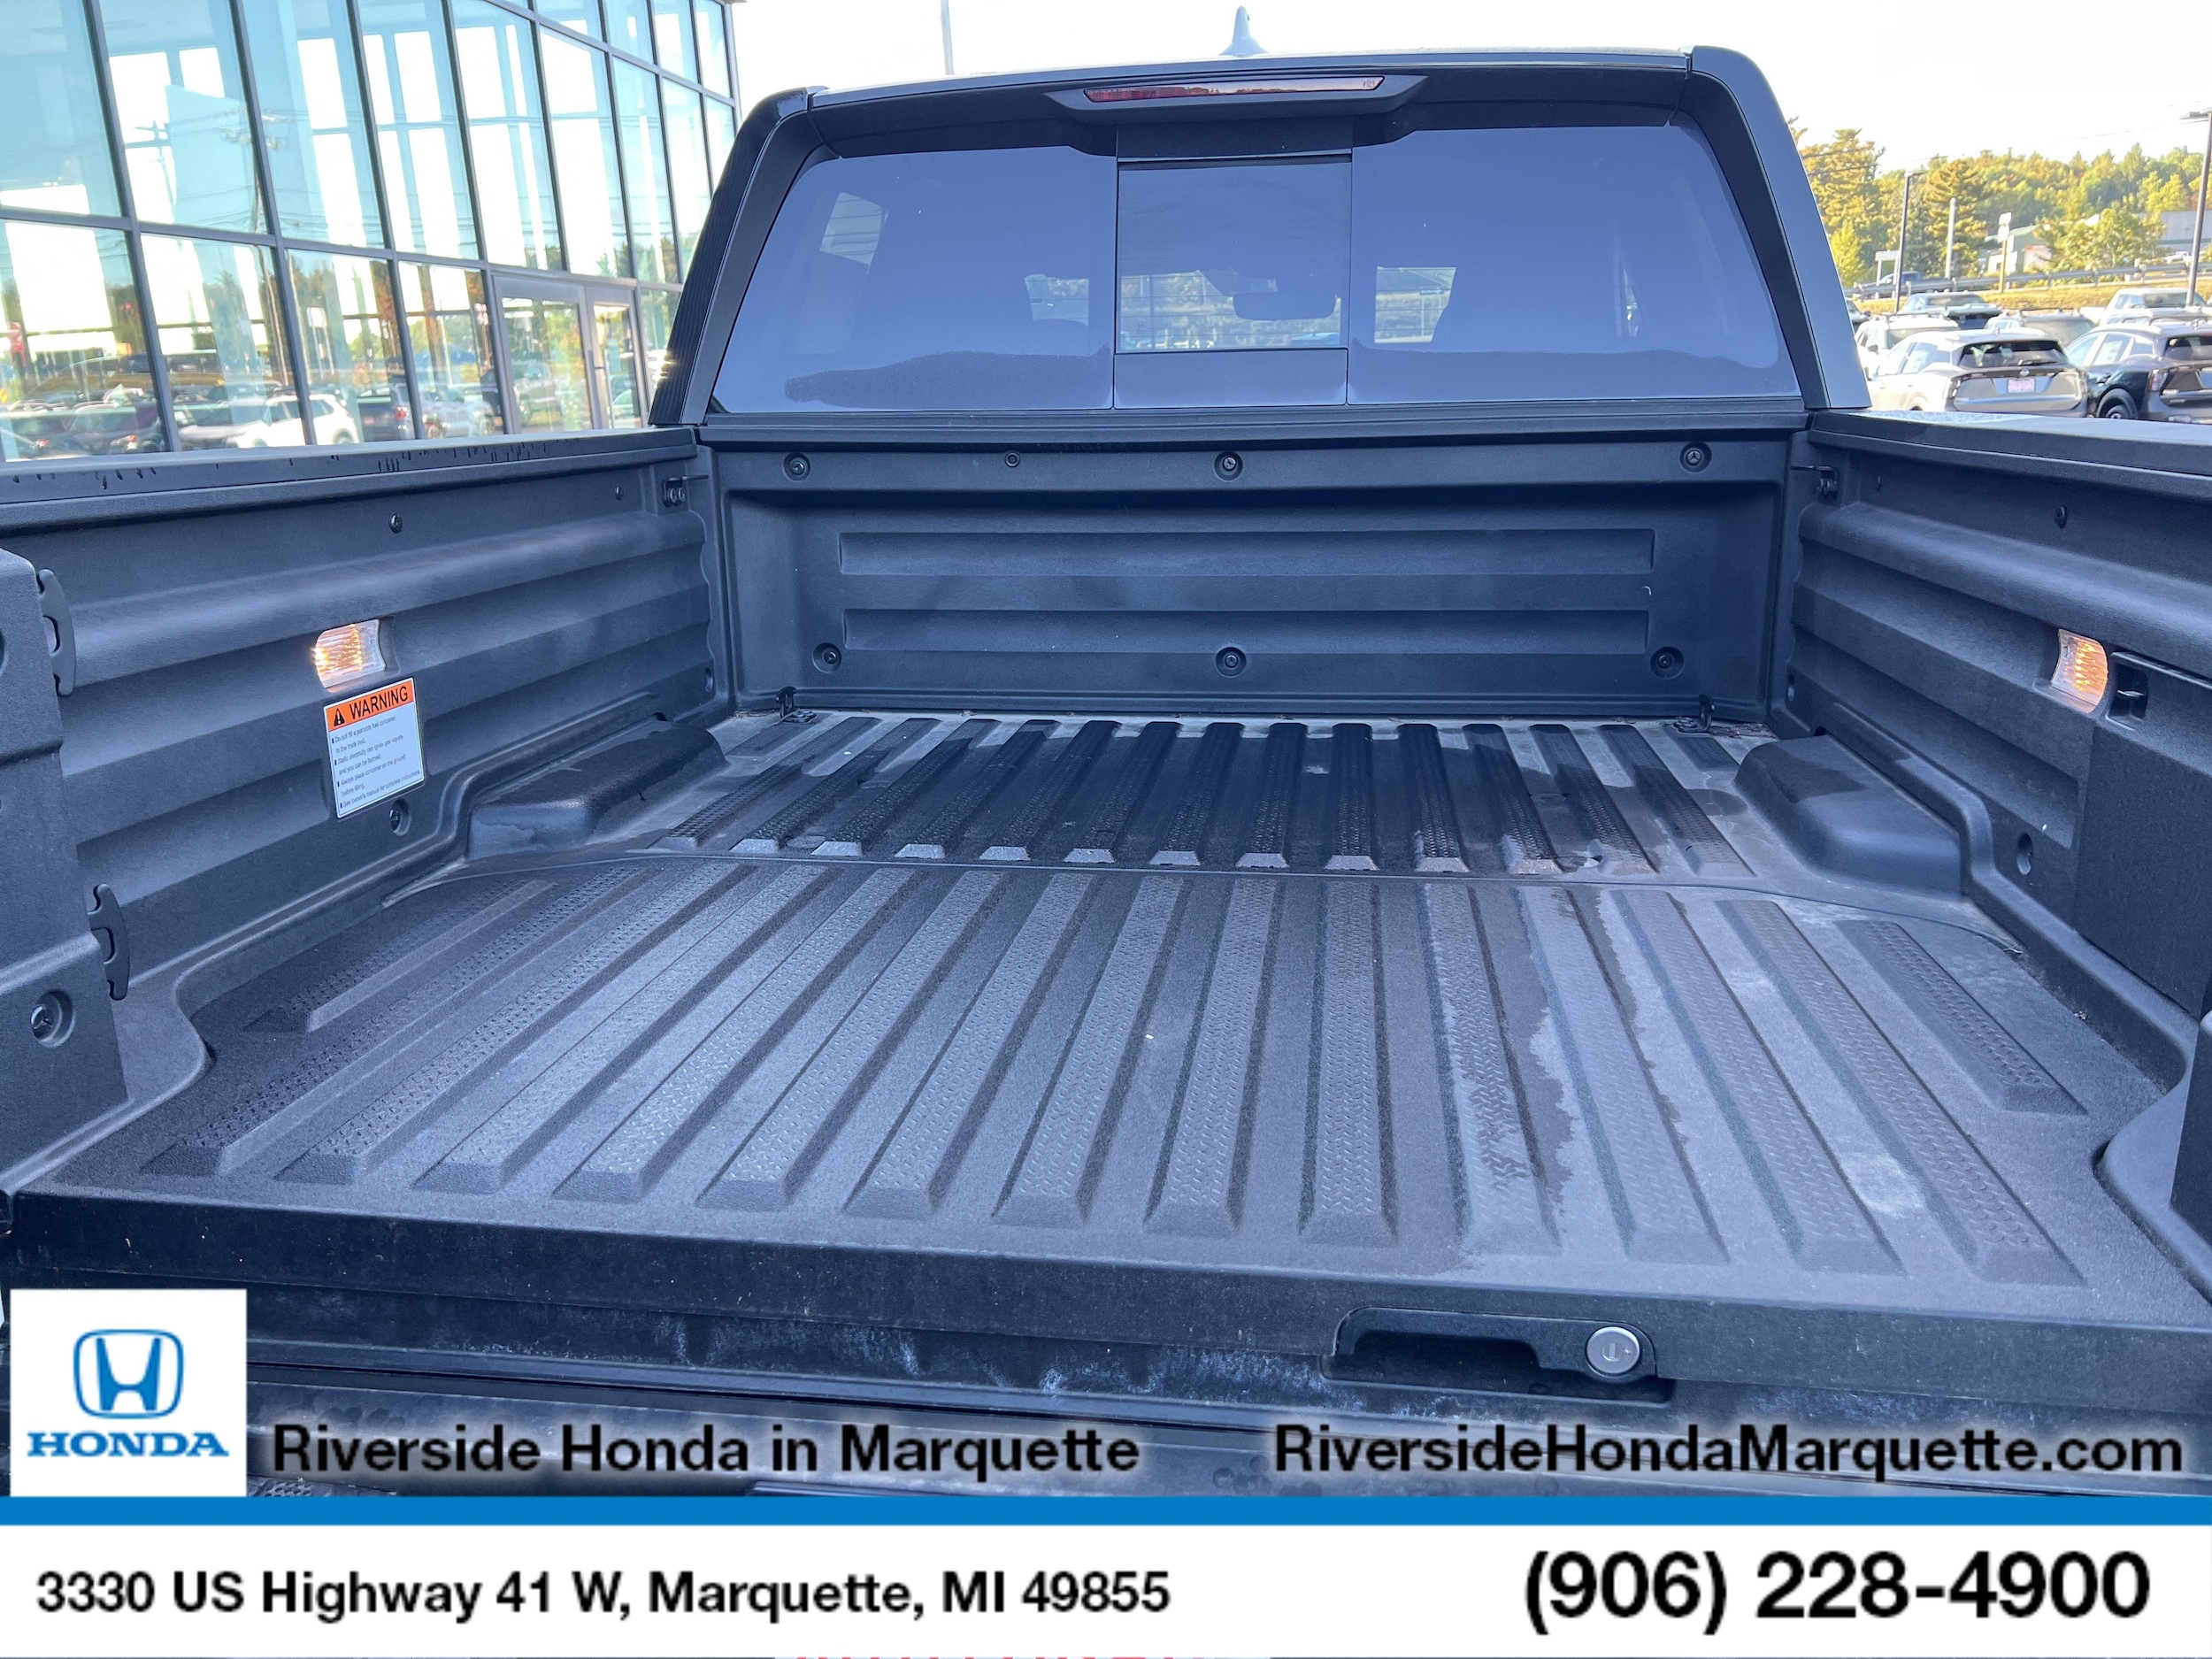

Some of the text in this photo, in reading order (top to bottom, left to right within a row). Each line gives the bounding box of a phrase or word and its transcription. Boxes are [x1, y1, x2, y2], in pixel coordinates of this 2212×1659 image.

[349, 686, 408, 719] WARNING
[357, 725, 372, 735] portable
[380, 716, 396, 726] container
[337, 756, 349, 764] Static
[349, 749, 366, 760] electricity
[373, 742, 384, 751] ignite
[340, 776, 354, 786] Always
[354, 772, 365, 781] place
[365, 764, 381, 776] container
[393, 754, 406, 765] ground
[365, 786, 380, 796] manual
[385, 778, 401, 789] complete
